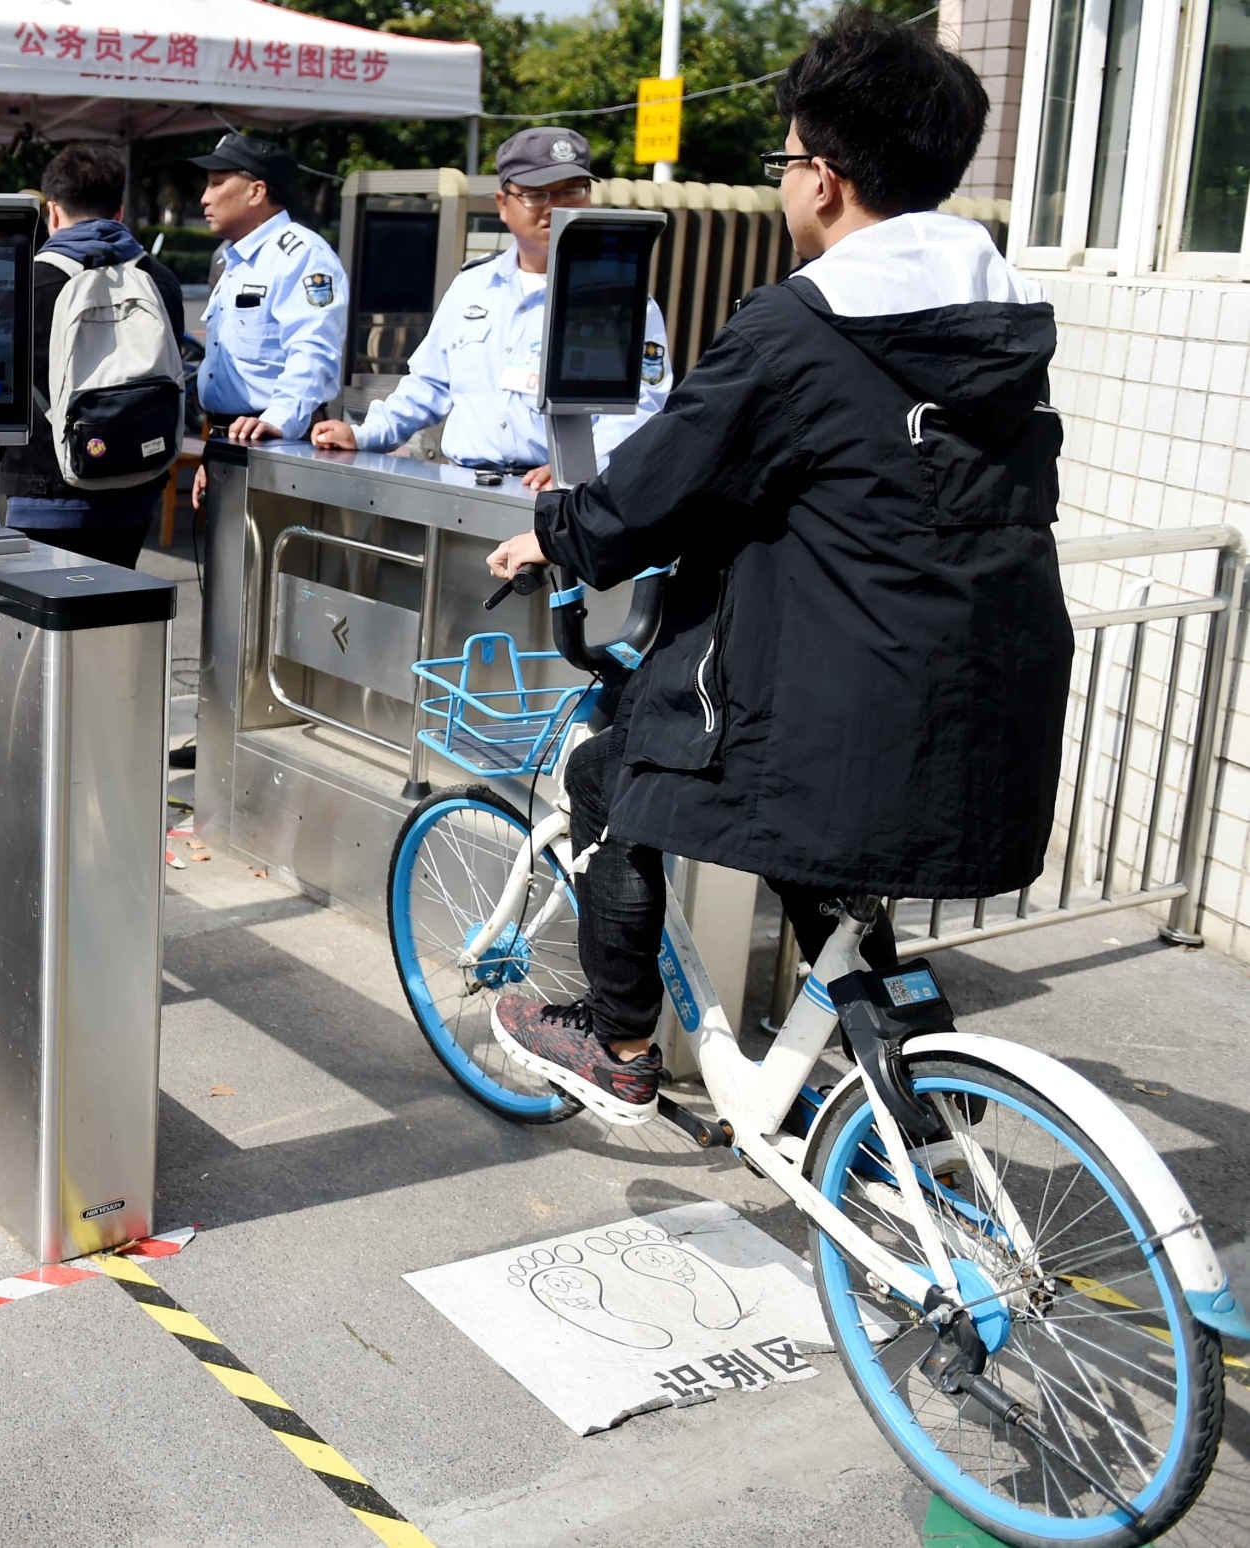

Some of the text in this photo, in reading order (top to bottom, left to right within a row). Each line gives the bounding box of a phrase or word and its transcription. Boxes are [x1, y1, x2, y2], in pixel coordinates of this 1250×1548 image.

[14, 22, 390, 83] 公务员之路 从华图起步
[654, 1335, 812, 1400] 识别区
